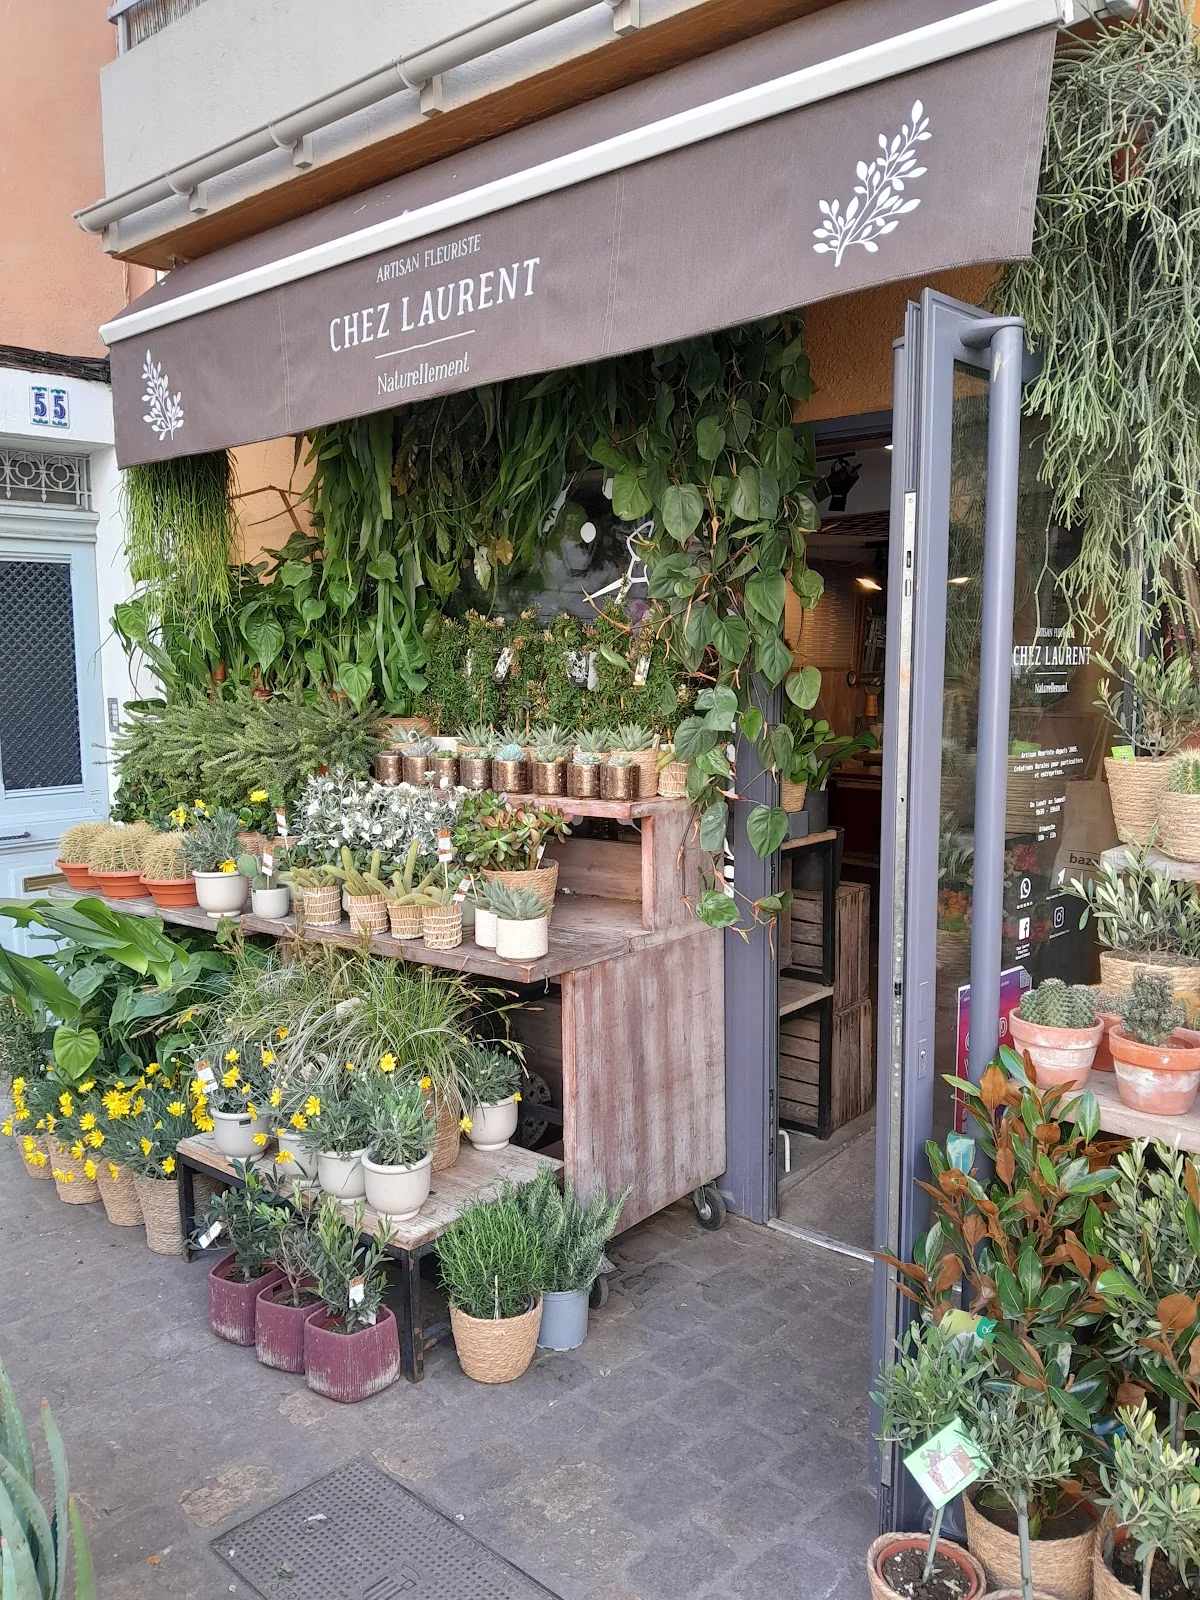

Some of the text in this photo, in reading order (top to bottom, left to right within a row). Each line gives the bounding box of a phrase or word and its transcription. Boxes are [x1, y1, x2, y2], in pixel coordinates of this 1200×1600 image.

[376, 234, 481, 283] ARTISAN FLEURISTE
[329, 257, 540, 352] CHEZ LAURENT
[377, 351, 470, 395] Naturellement
[34, 392, 66, 420] 55
[1013, 645, 1092, 666] CHEZ LAURENT
[270, 1582, 301, 1600] SER
